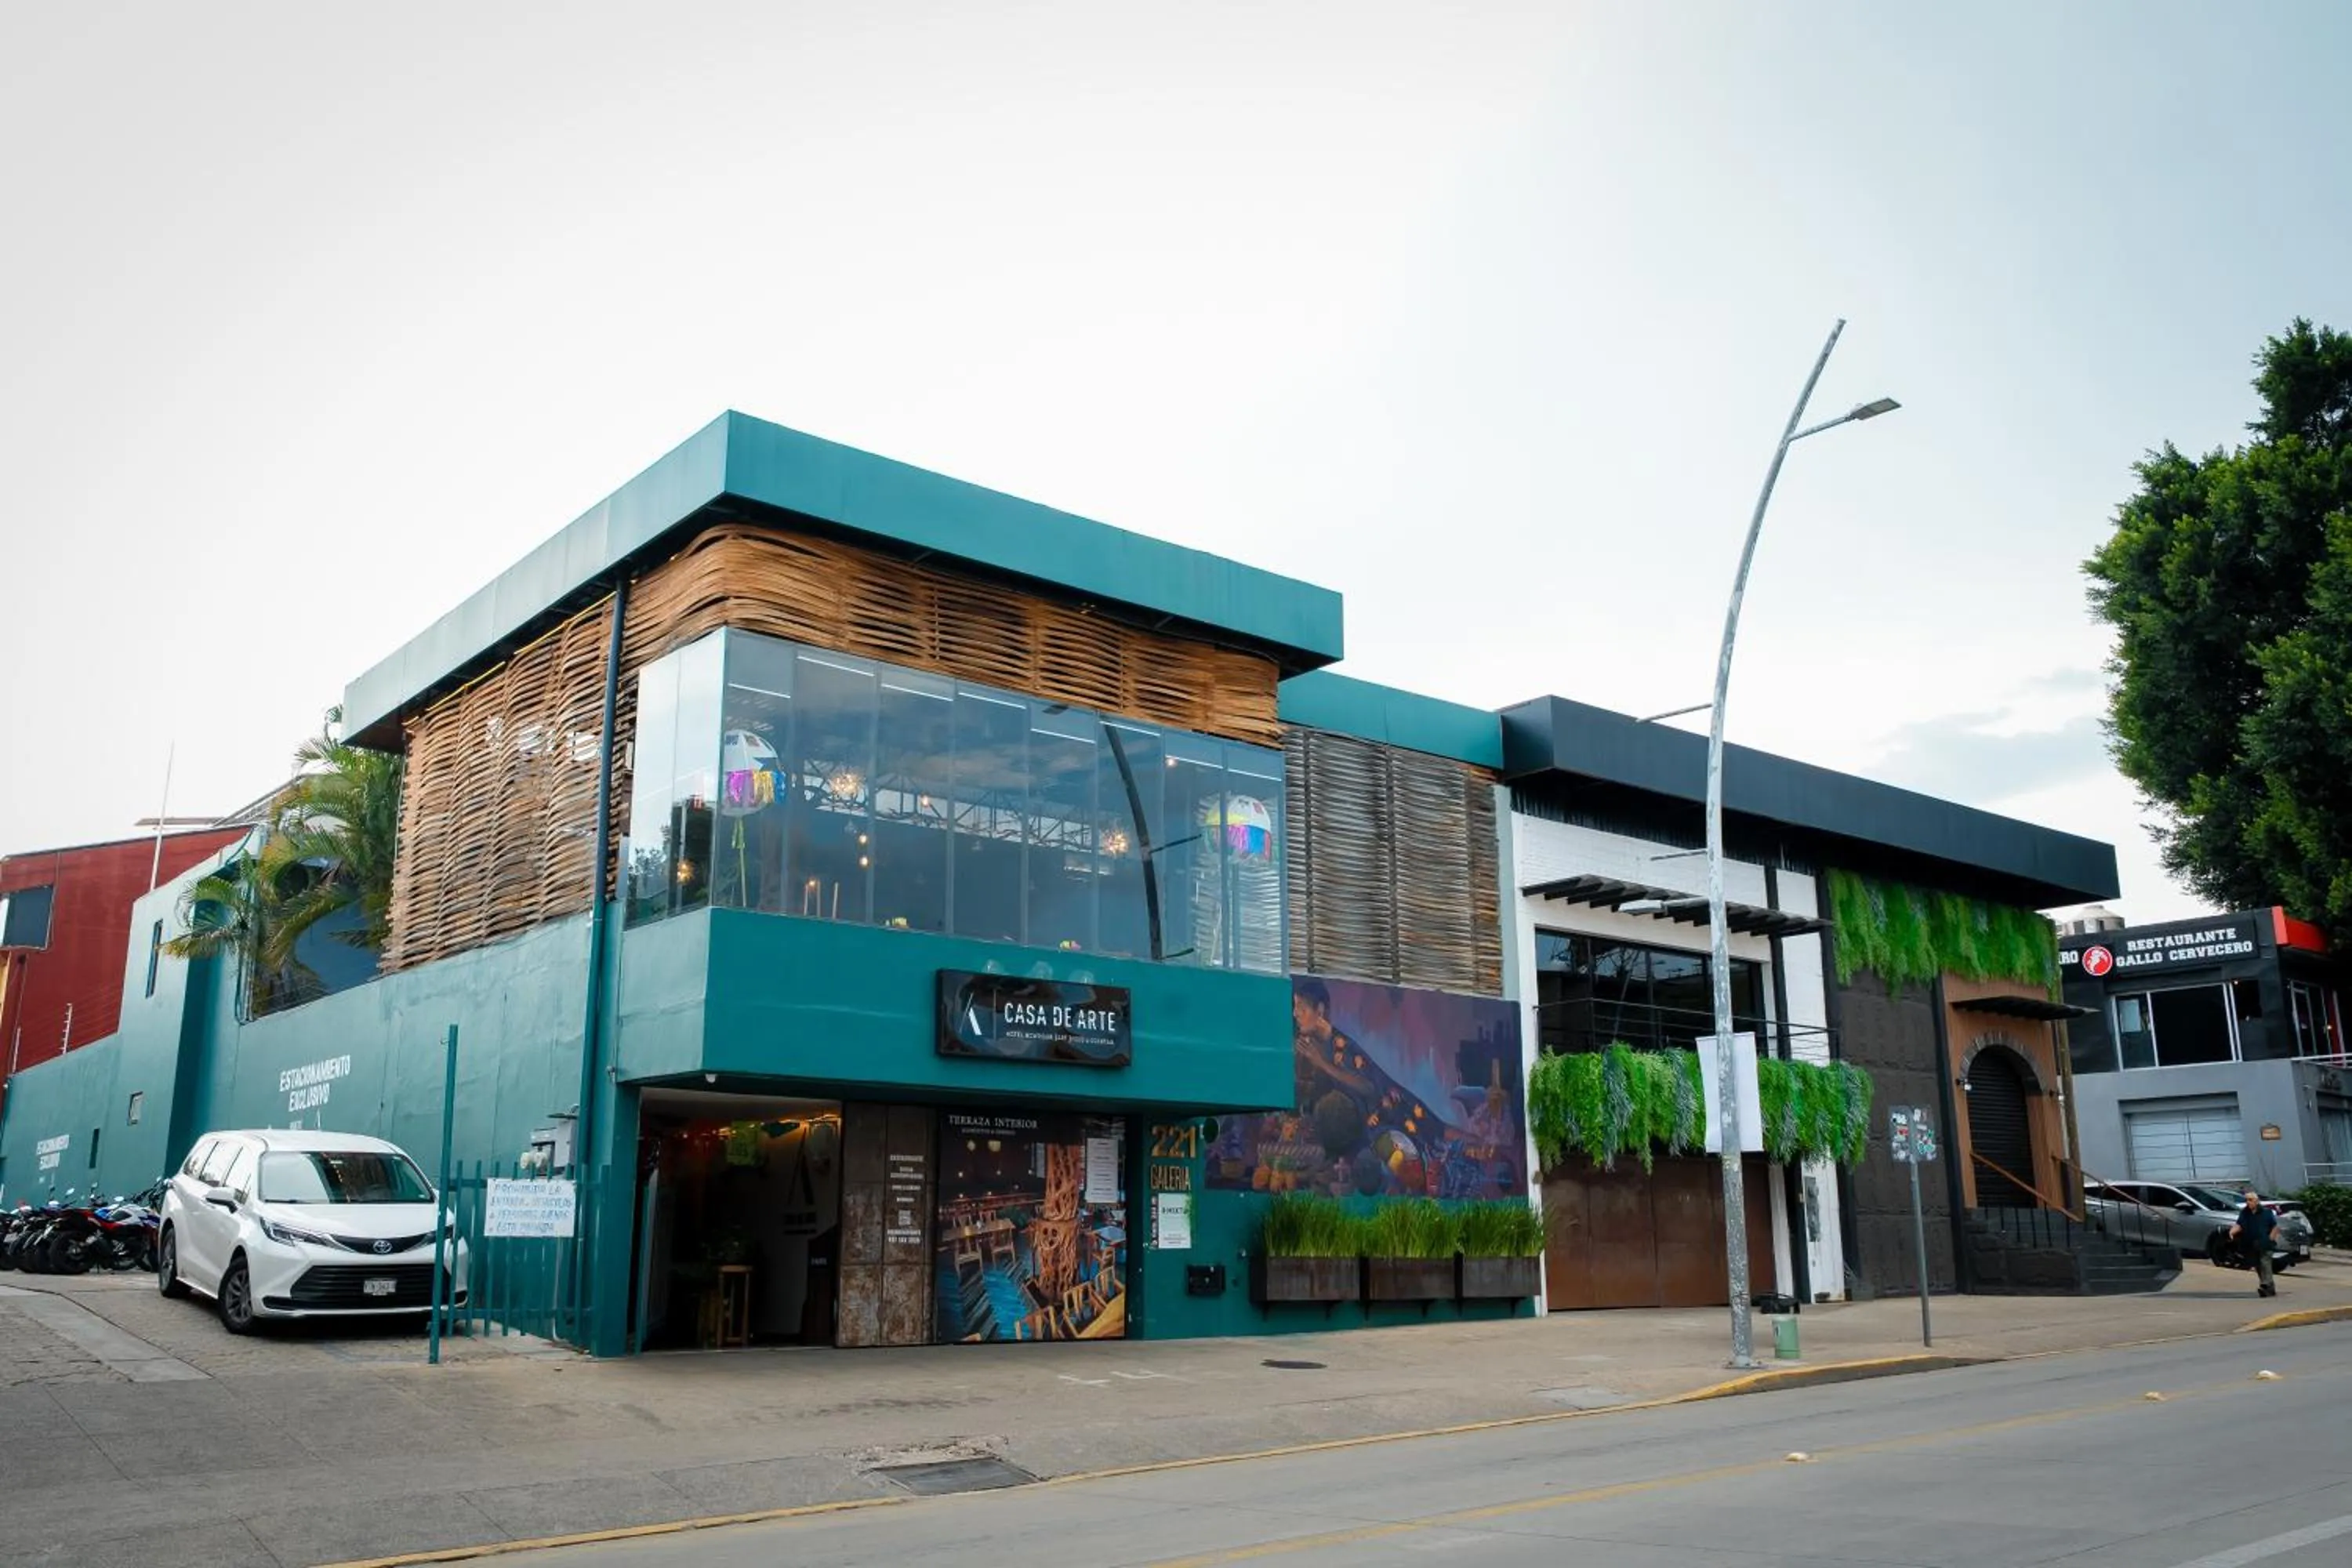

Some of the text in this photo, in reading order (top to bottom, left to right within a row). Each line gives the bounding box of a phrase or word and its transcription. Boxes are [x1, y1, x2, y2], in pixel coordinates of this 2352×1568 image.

[2115, 940, 2252, 967] GALLO CERVECERO
[2126, 927, 2237, 952] RESTAURANTE
[1004, 1002, 1116, 1033] CASA DE ARTE
[279, 1054, 351, 1092] ESTACIONAMIENTO
[288, 1082, 330, 1112] EXCLUSIVO
[949, 1114, 1037, 1129] TERRAZA INTERIOR
[1151, 1125, 1196, 1158] 221
[1150, 1164, 1192, 1191] GALERIA
